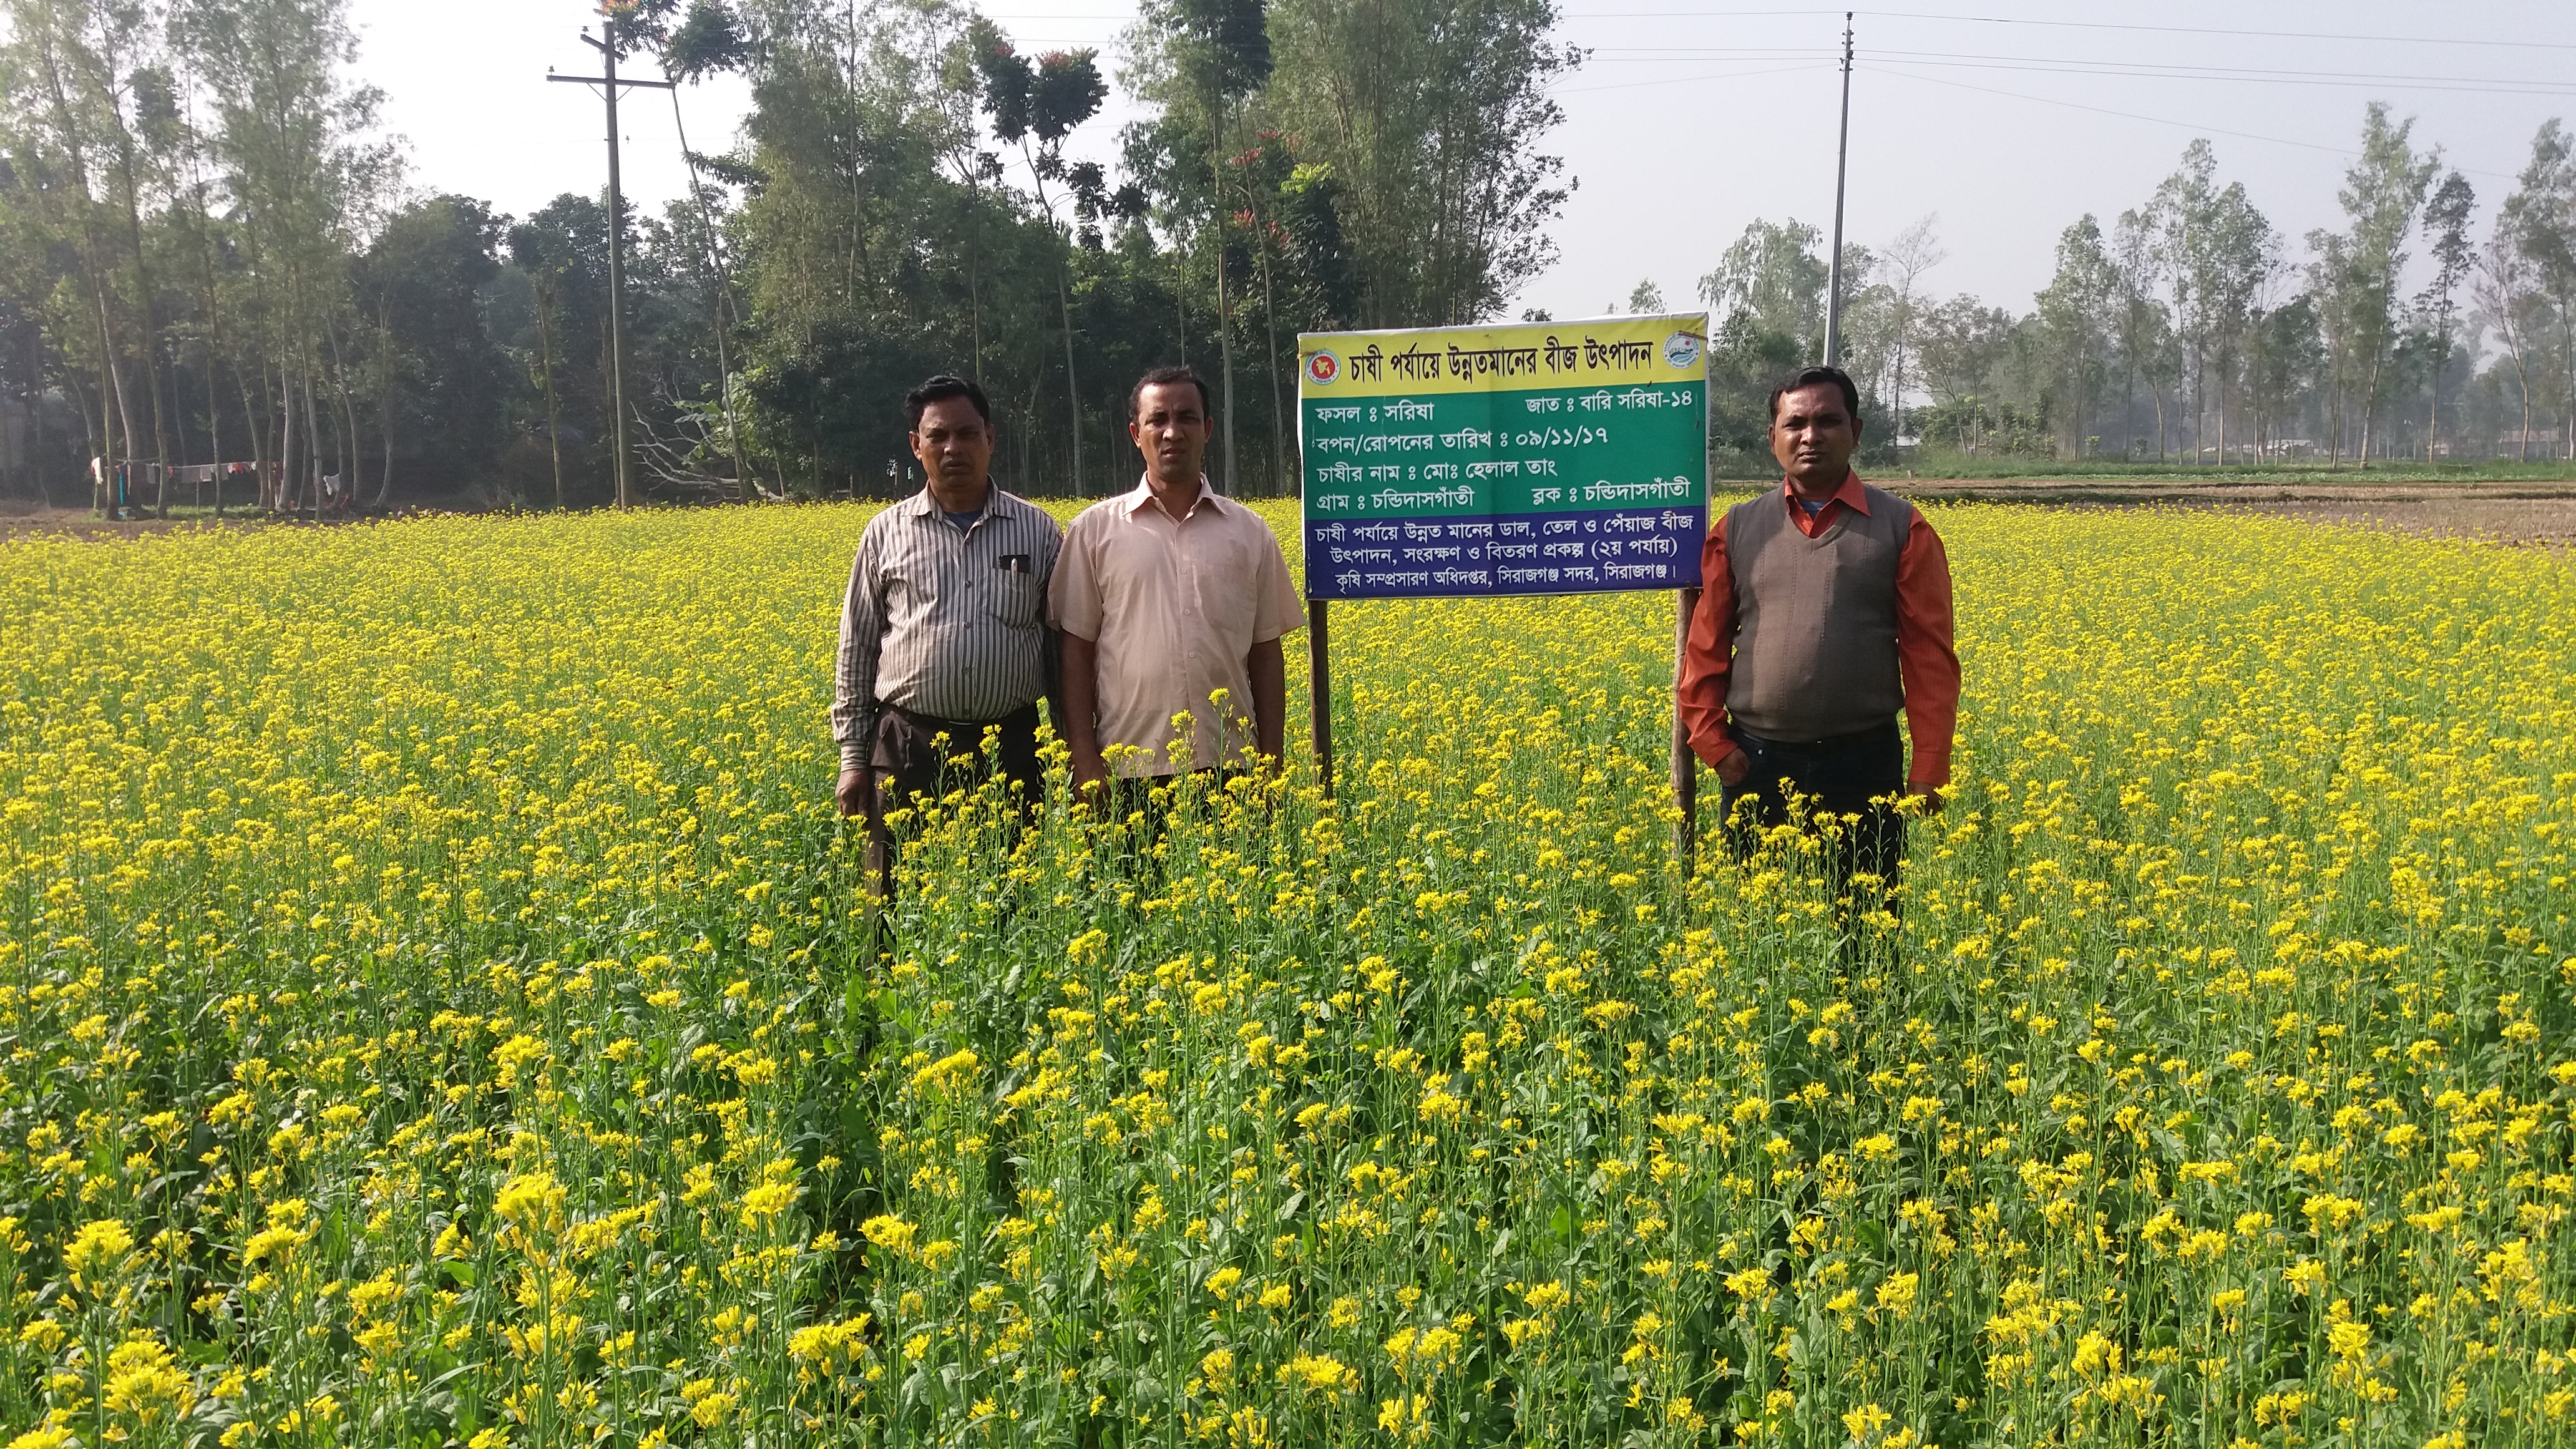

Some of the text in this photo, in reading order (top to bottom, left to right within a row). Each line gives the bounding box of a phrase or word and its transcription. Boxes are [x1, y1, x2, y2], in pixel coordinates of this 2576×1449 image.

[1349, 344, 1383, 384] চাষী
[1391, 342, 1442, 381] পর্যায়ে
[1447, 343, 1538, 384] উন্নতমানের
[1544, 336, 1578, 375] বীজ
[1584, 335, 1654, 371] উৎপাদন
[1315, 407, 1362, 424] ফসল
[1383, 399, 1435, 421] সরিষা
[1525, 397, 1561, 414] জাত
[1579, 390, 1613, 411] বারি
[1617, 388, 1692, 409] সরিষা-১৪
[1315, 434, 1434, 456] বপন/রোপনের
[1439, 427, 1492, 449] তারিখ
[1516, 425, 1608, 449] ০৯/১১/১৭
[1317, 461, 1363, 483] চাষীর
[1368, 466, 1400, 482] নাম
[1423, 462, 1458, 480] মোঃ
[1466, 460, 1520, 481] হেলাল
[1525, 458, 1558, 476] তাং
[1317, 494, 1350, 512] গ্রাম
[1531, 487, 1561, 505] ব্লক
[1315, 510, 1694, 544] চাষী পর্যায়ে উন্নত মানের ডাল, তেল ও পেঁয়াজ বীজ
[1329, 534, 1677, 567] উৎপাদন, সংরক্ষণ ও বিতরণ প্রকল্প (২য় পর্যায়)
[1335, 569, 1361, 595] কৃষি
[1433, 566, 1492, 588] অধিদপ্তর,
[1496, 565, 1559, 585] সিরাজগঞ্জ
[1563, 566, 1599, 584] সদর,
[1603, 561, 1667, 580] সিরাজগঞ্জ
